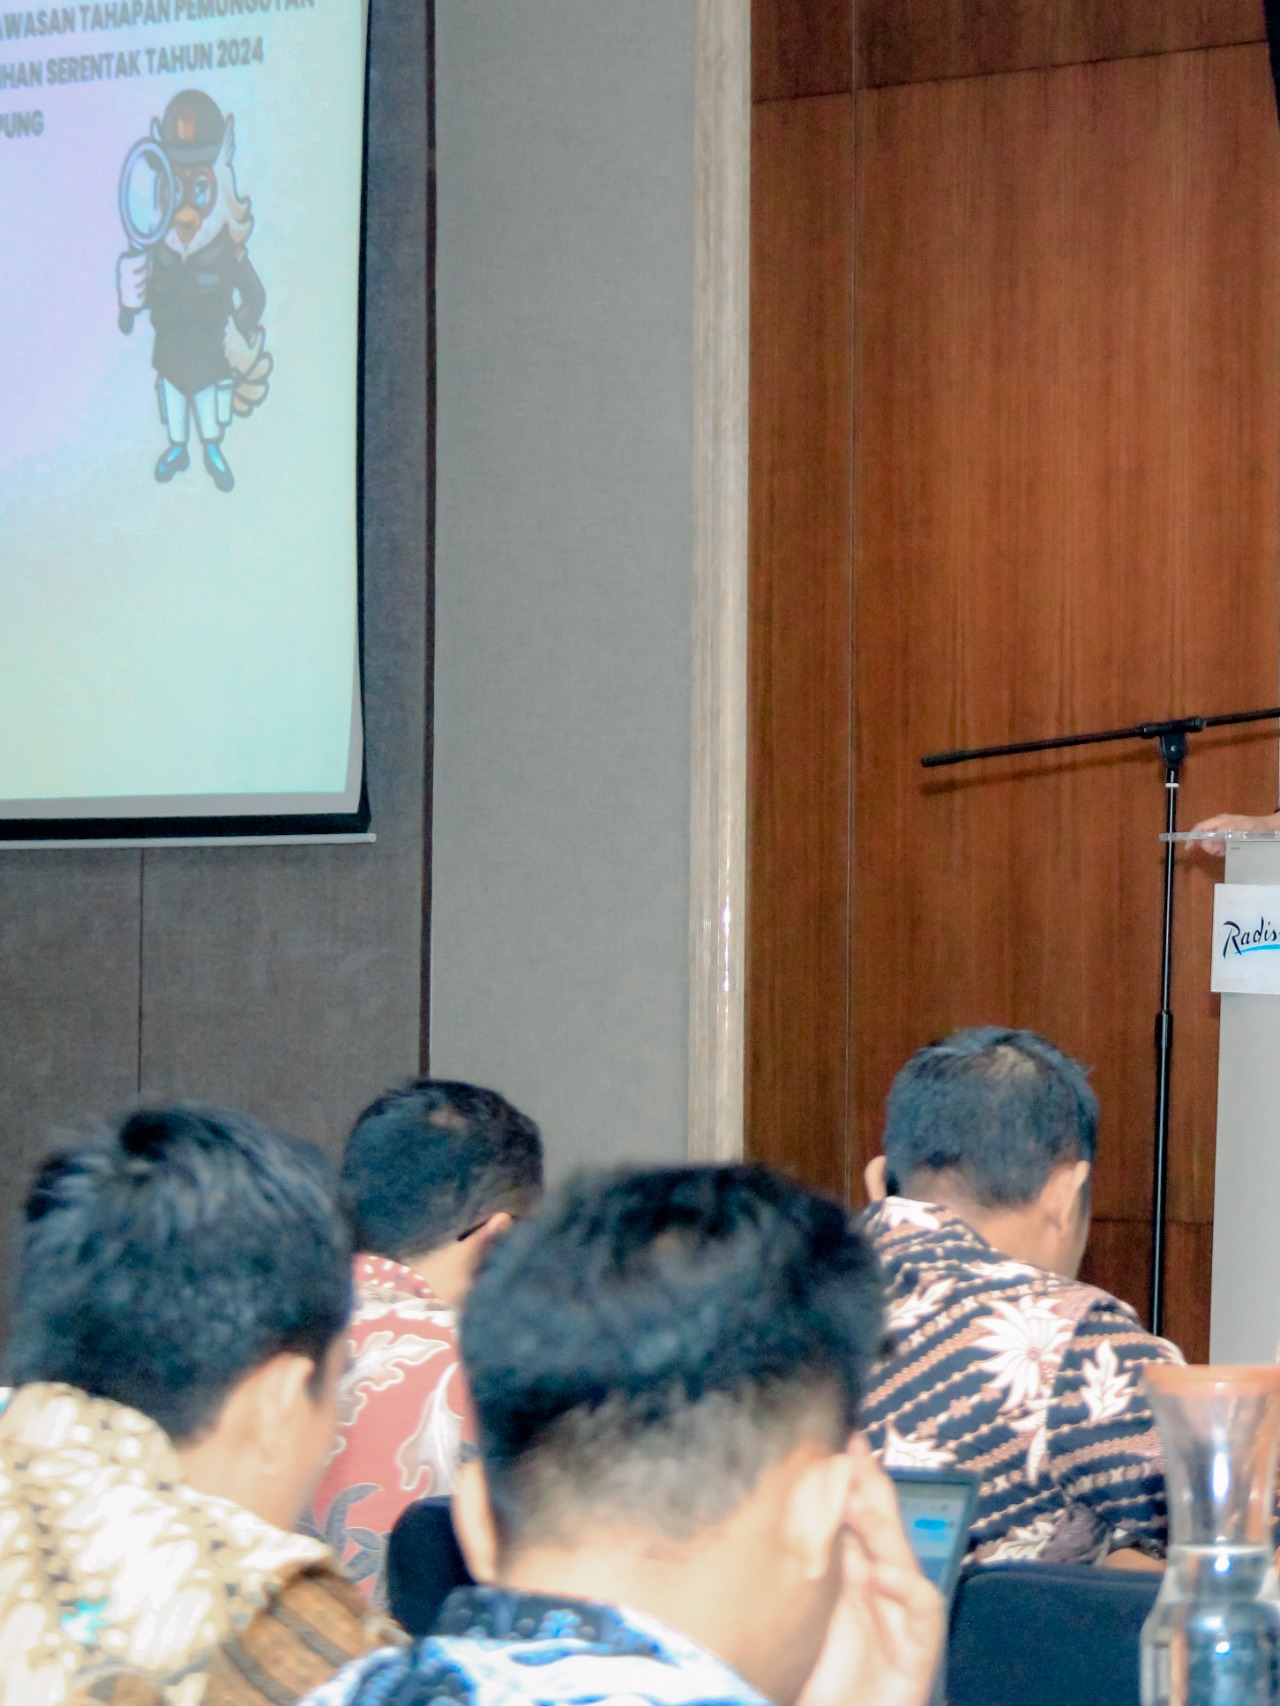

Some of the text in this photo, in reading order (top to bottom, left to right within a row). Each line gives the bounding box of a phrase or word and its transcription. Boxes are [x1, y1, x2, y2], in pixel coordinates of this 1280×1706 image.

[0, 7, 76, 40] WASAN
[78, 0, 170, 32] TAHAPAN
[46, 49, 142, 86] SERENTAK
[144, 42, 214, 76] TAHUN
[216, 35, 265, 69] 2024
